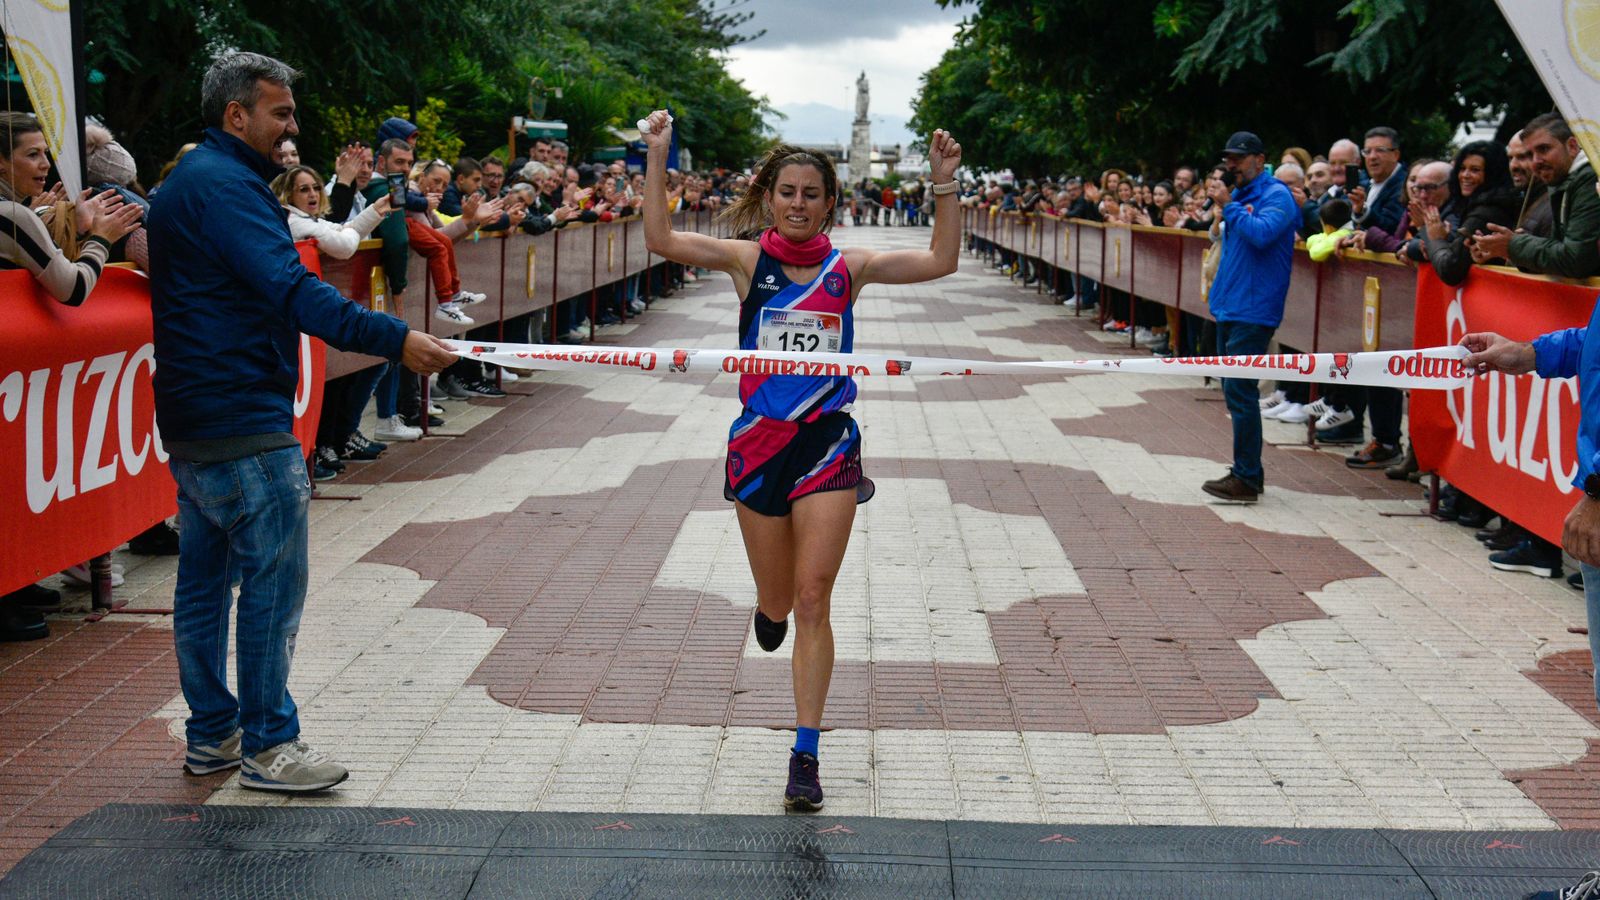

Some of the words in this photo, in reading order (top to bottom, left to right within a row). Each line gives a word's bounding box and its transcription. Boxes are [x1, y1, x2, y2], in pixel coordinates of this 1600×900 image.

[757, 283, 780, 291] VIATOR
[778, 331, 820, 353] 152
[1388, 352, 1473, 379] ampo
[0, 343, 170, 514] uzc
